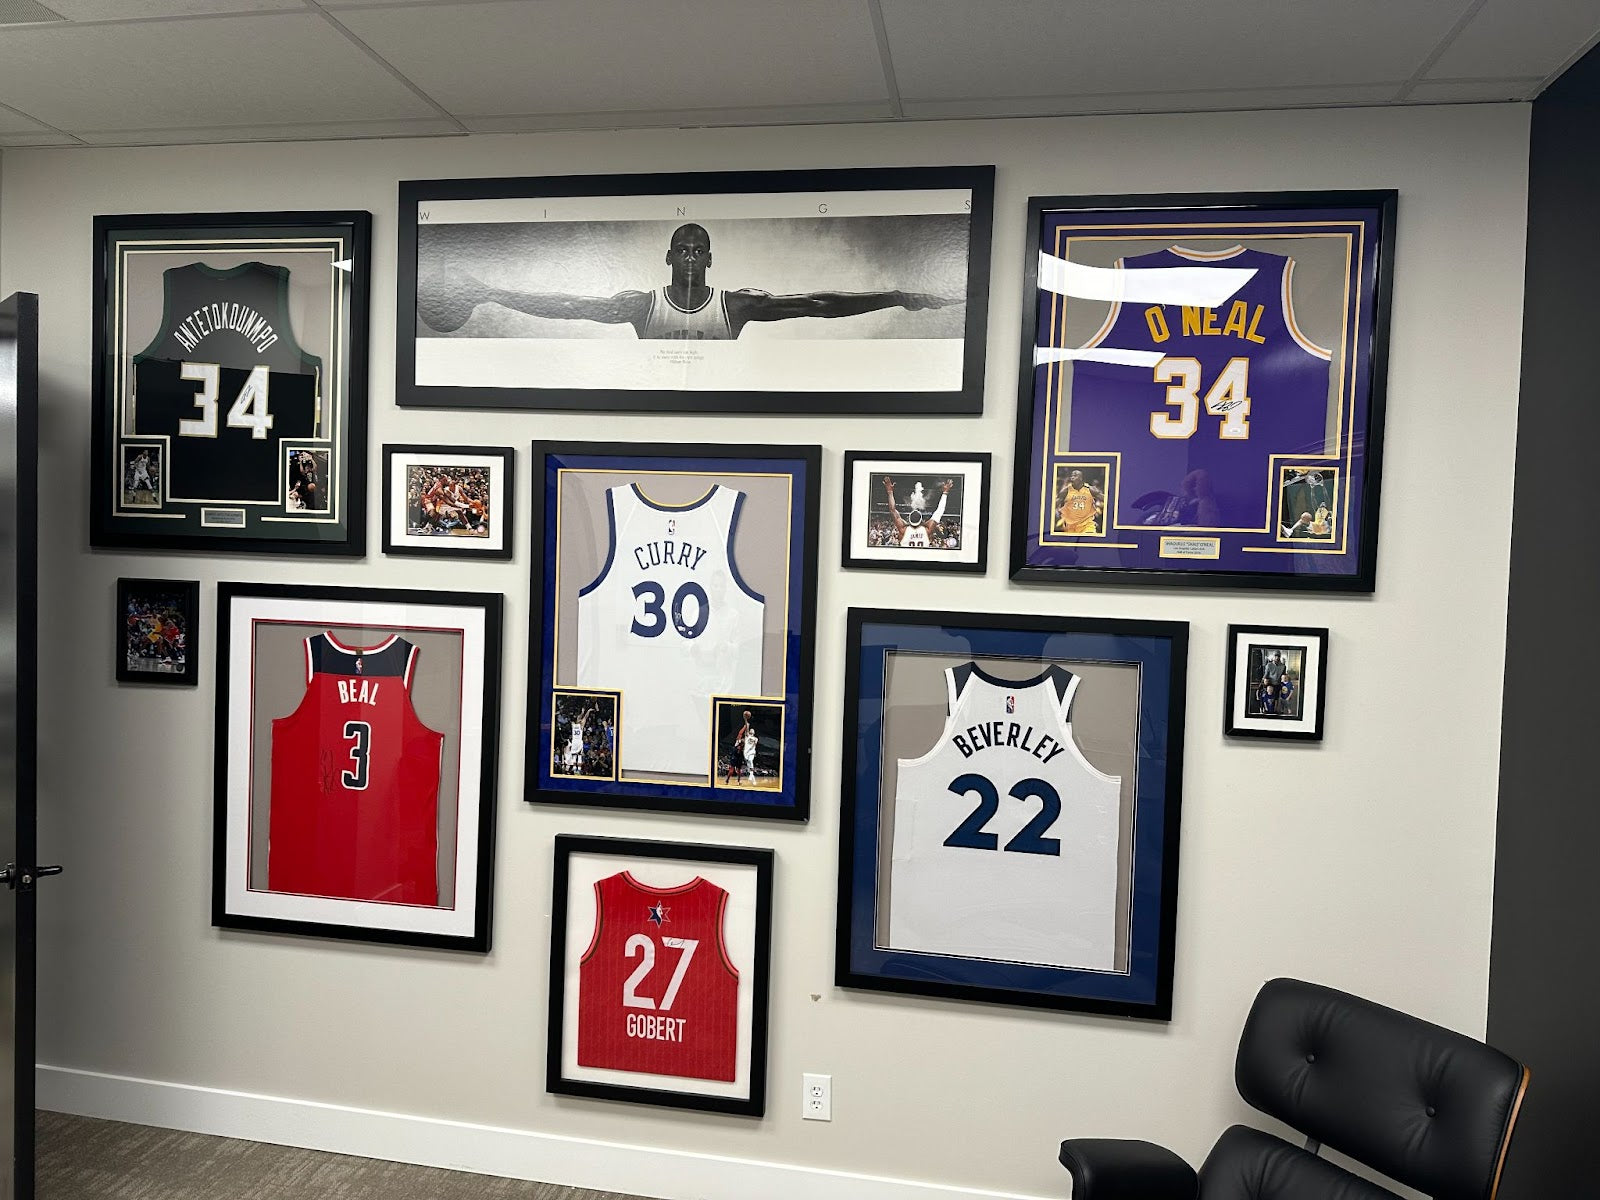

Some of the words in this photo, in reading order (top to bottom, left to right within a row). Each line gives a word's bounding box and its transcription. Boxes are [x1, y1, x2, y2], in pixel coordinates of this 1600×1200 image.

[419, 212, 430, 220] W
[676, 206, 686, 216] N
[818, 203, 828, 214] G
[964, 199, 972, 210] S
[174, 302, 278, 353] ANTETOKOUNMPO
[178, 361, 275, 440] 34
[1149, 356, 1252, 440] 34
[1072, 501, 1085, 510] 34
[634, 540, 708, 571] CURRY
[630, 581, 710, 639] 30
[337, 680, 378, 704] BEAL
[340, 720, 371, 791] 3
[952, 721, 1065, 765] BEVERLEY
[942, 773, 1062, 857] 22
[622, 933, 700, 1012] 27
[626, 1013, 687, 1043] GOBERT
